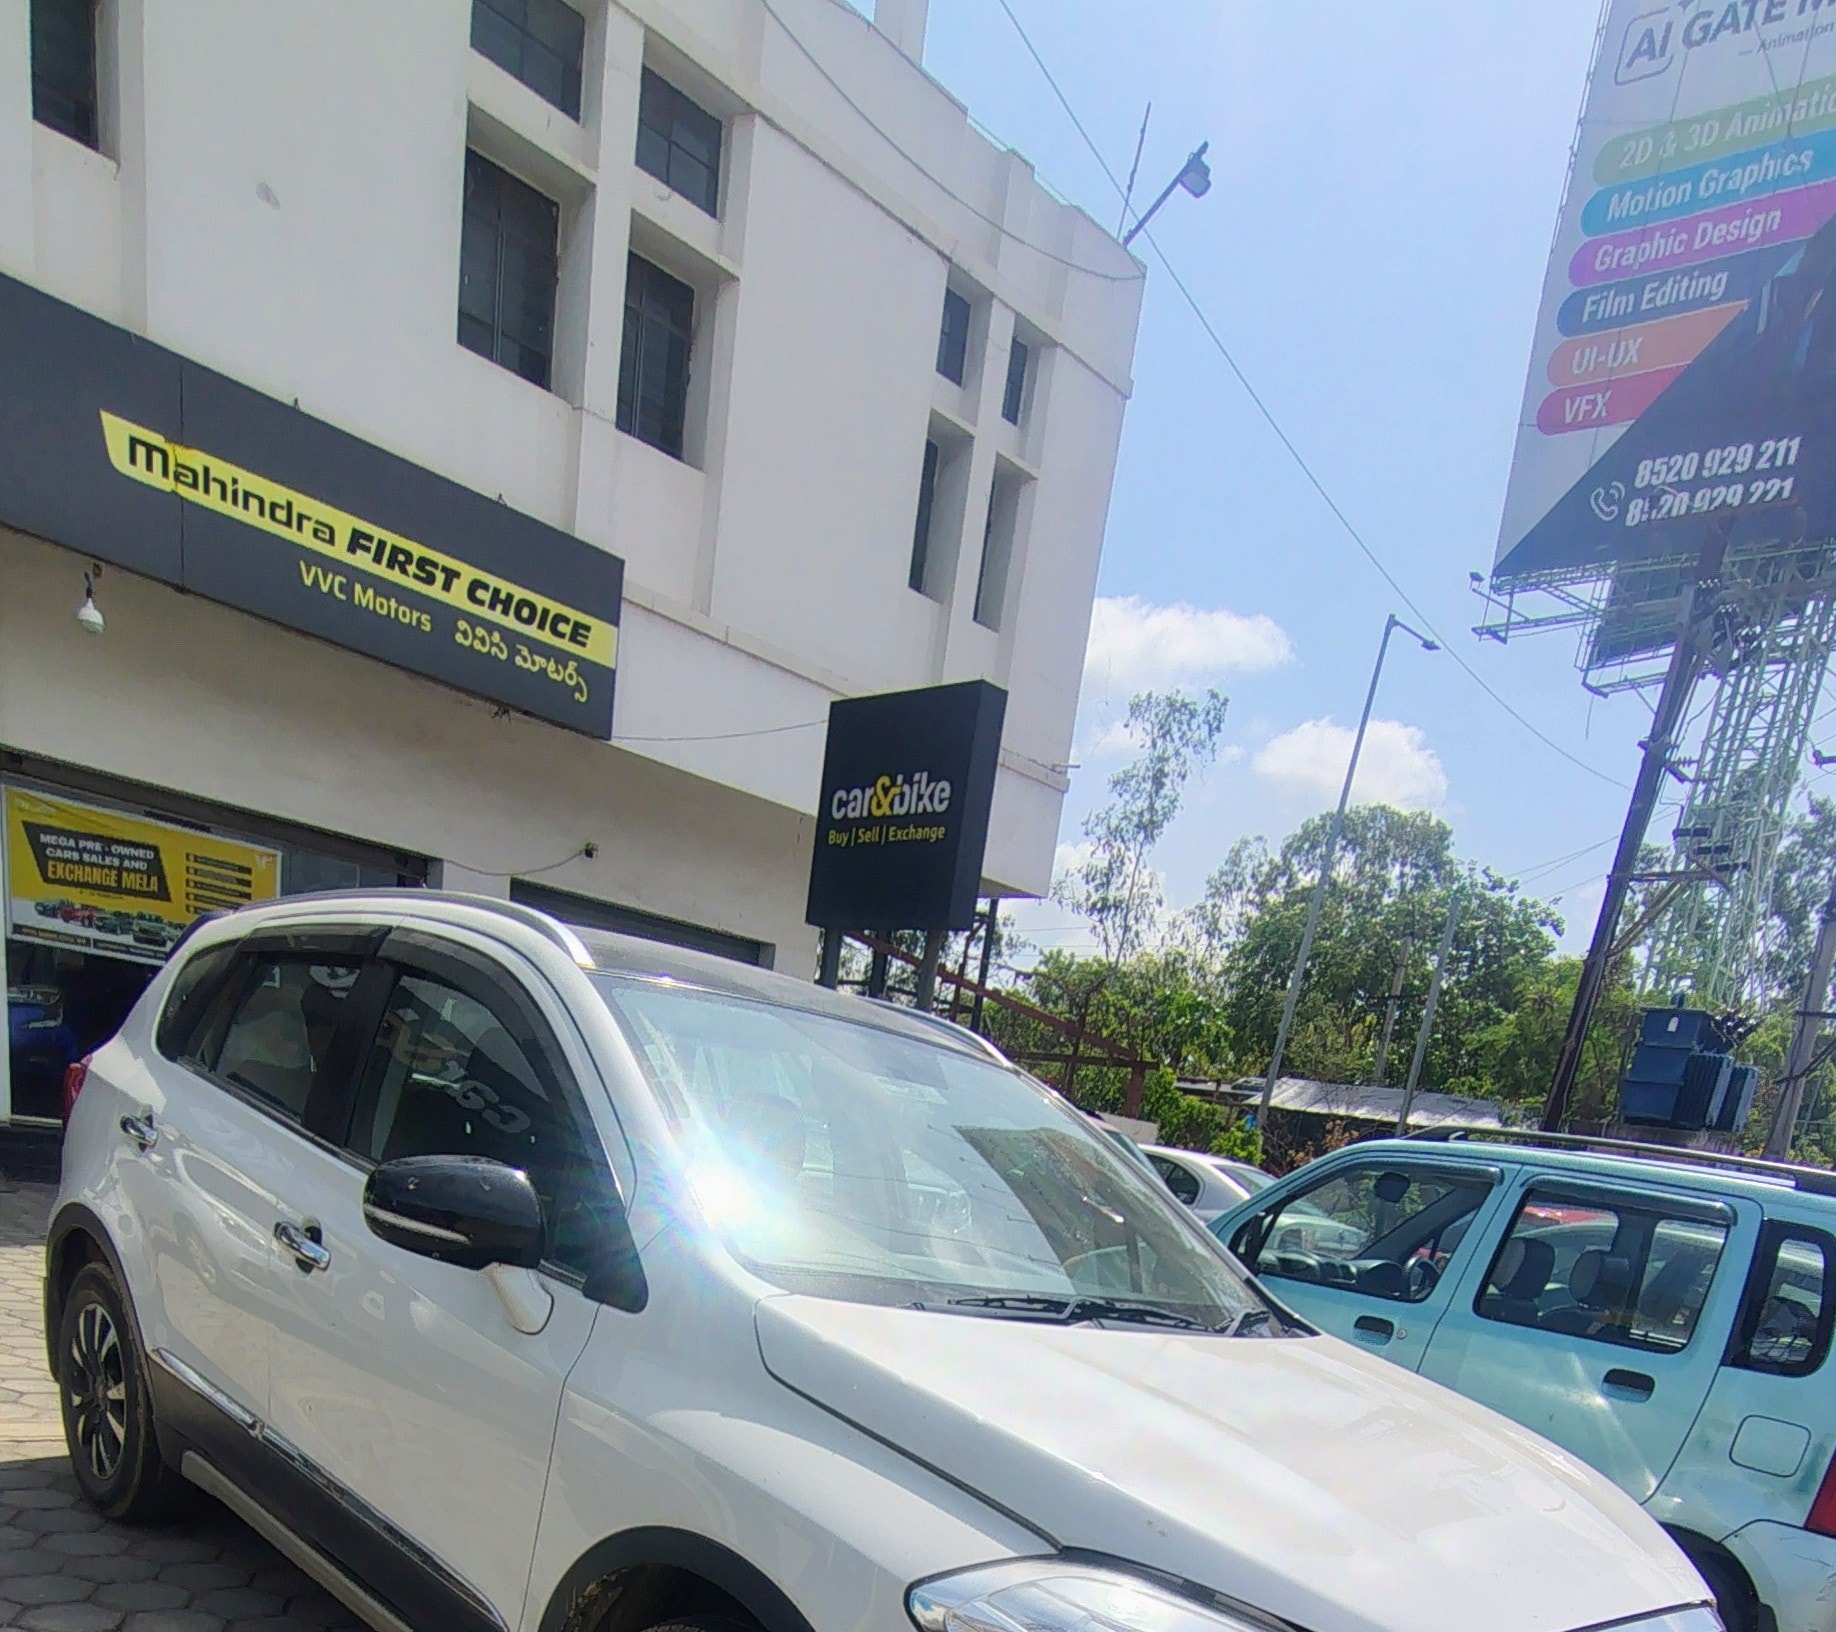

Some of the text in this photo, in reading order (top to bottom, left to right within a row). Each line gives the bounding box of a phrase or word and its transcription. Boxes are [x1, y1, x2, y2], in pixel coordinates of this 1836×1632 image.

[1618, 137, 1653, 170] 2D
[1684, 119, 1720, 151] 3D
[1606, 149, 1814, 222] Motion Graphics
[1593, 207, 1782, 272] Graphic Design
[1582, 270, 1729, 324] Film Editing
[1572, 337, 1643, 375] UI-UX
[1564, 390, 1612, 424] VFX
[1633, 435, 1802, 489] 8520 929 211
[300, 560, 432, 632] VVC Motors
[347, 527, 461, 592] FIRST
[467, 578, 592, 648] CHOICE
[832, 771, 951, 820] car&bike
[40, 833, 76, 848] MEGA
[78, 839, 102, 851] PRE
[111, 844, 154, 859] OWNED
[45, 847, 147, 870] CARS SALES AND
[828, 829, 849, 847] Buy
[857, 826, 880, 843] Sell
[888, 824, 945, 842] Exchange
[47, 860, 158, 892] EXCHANGE MELA
